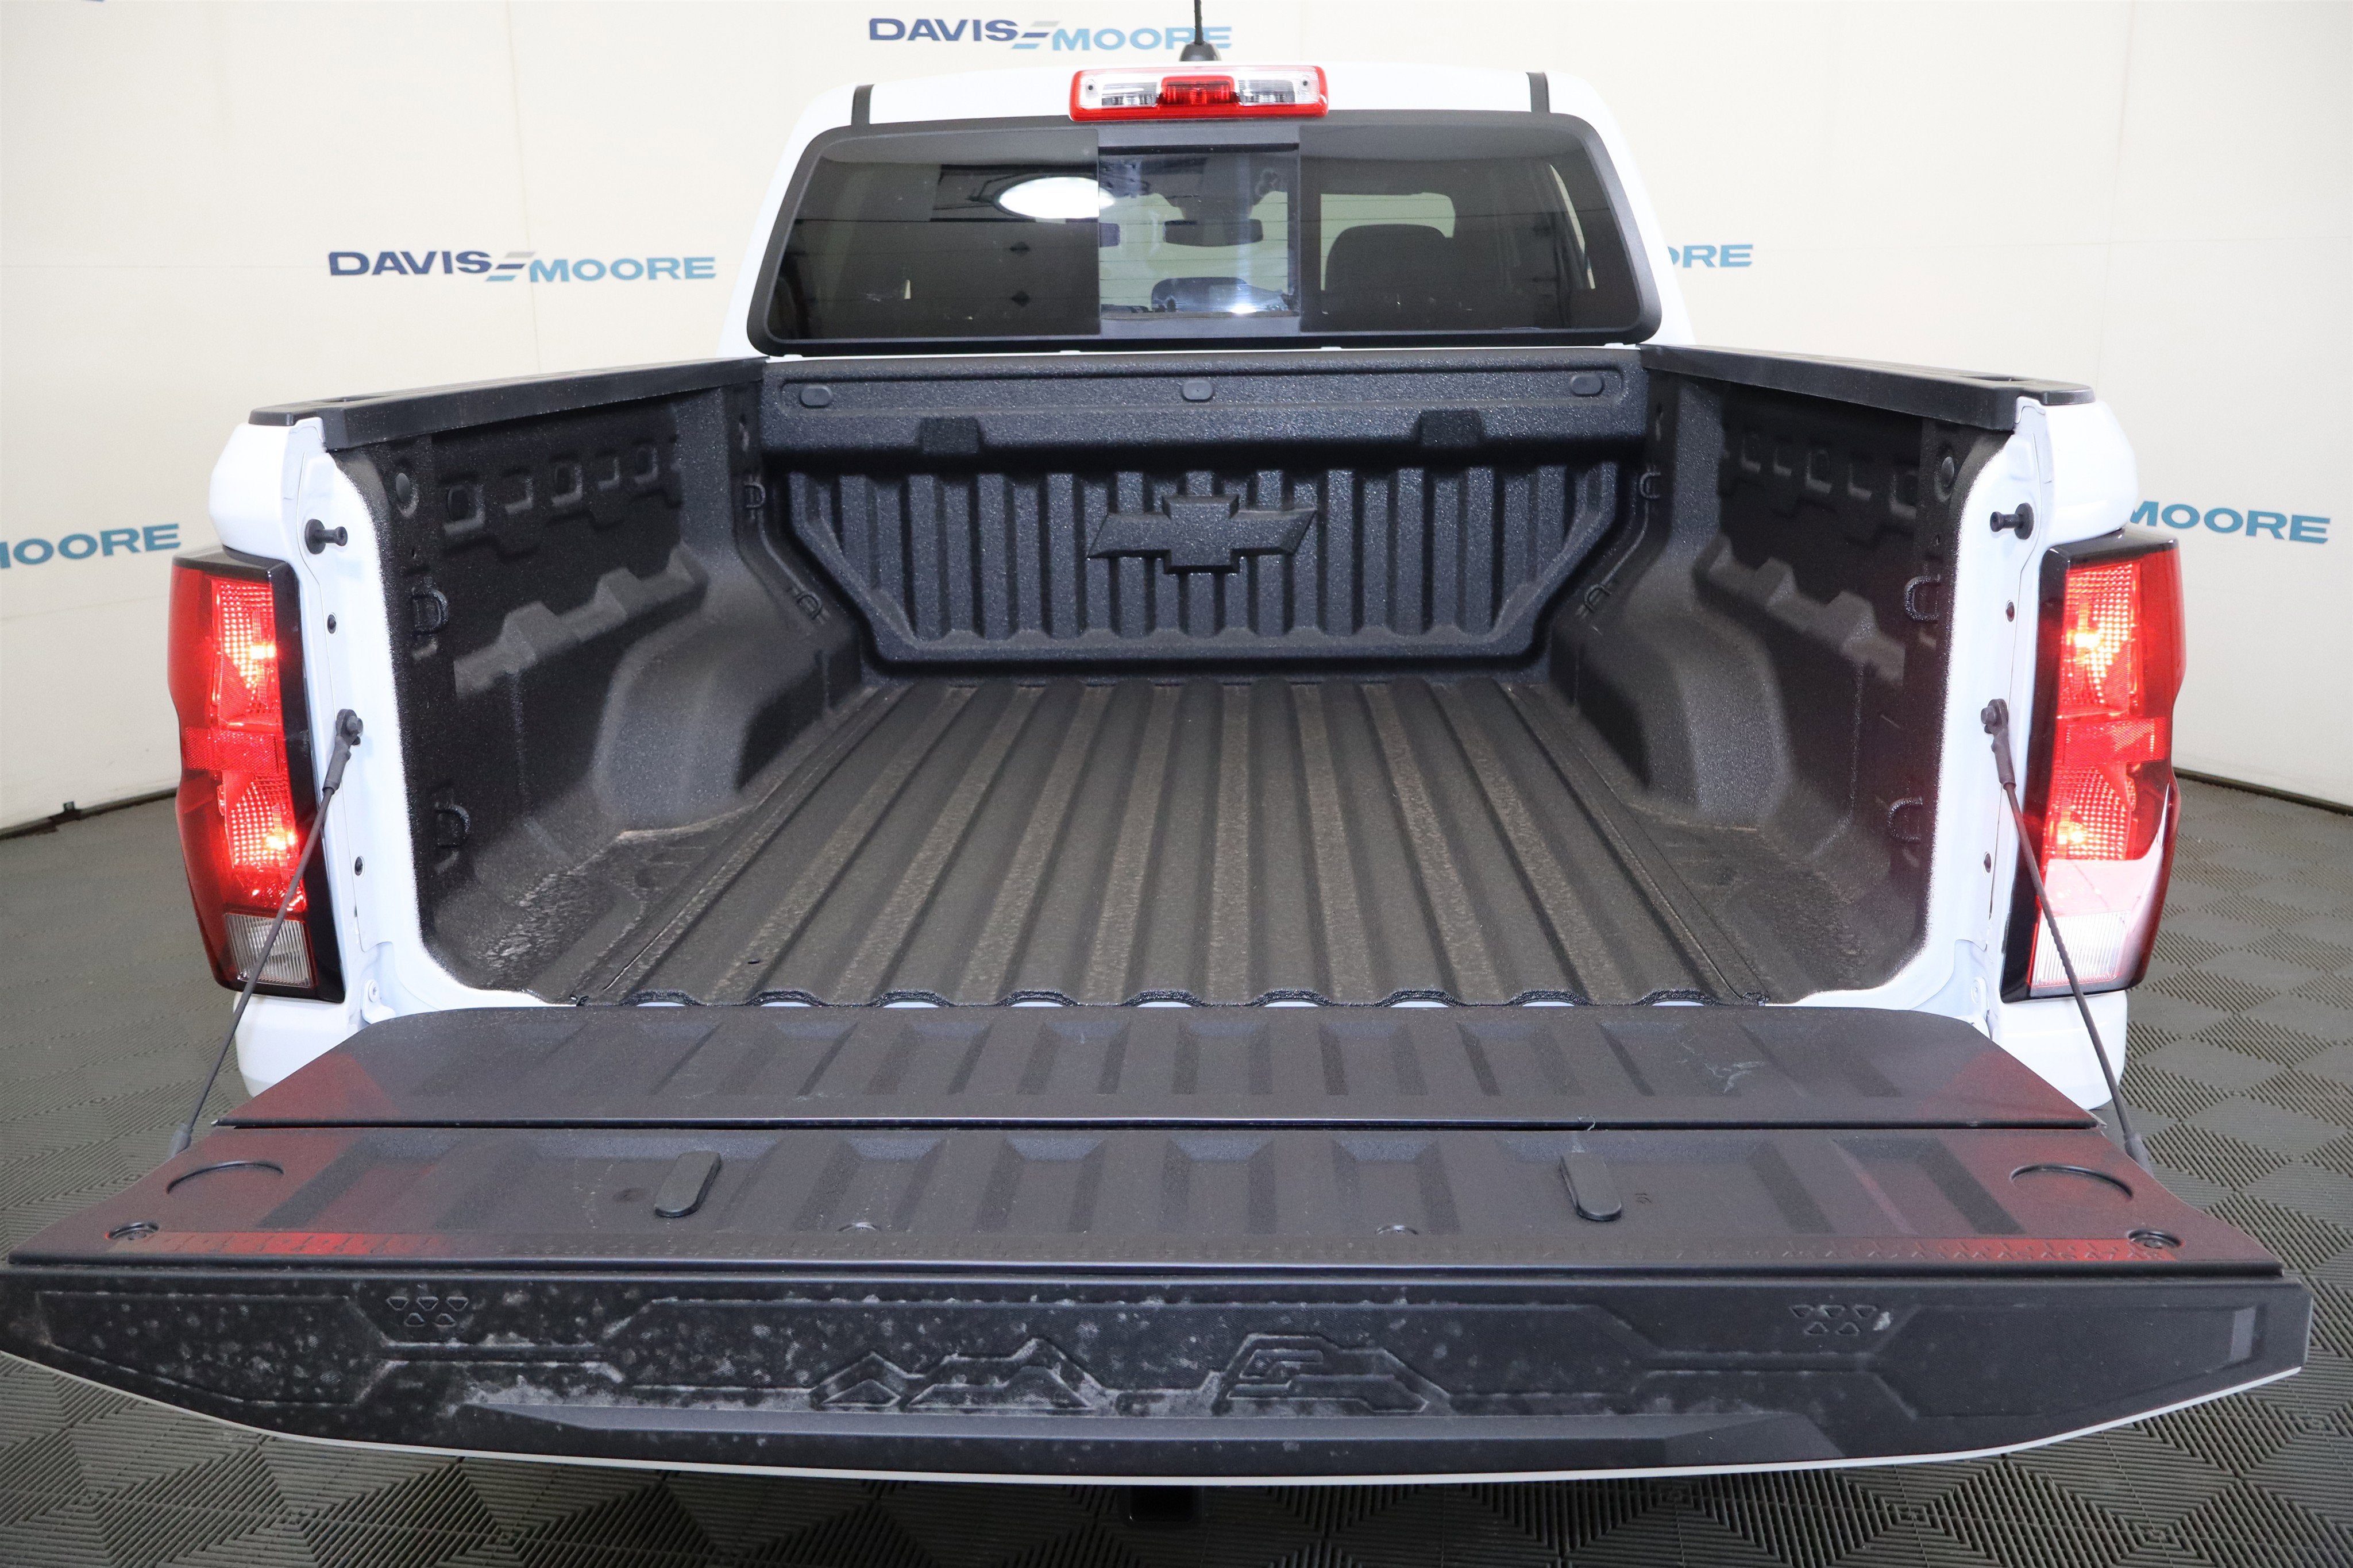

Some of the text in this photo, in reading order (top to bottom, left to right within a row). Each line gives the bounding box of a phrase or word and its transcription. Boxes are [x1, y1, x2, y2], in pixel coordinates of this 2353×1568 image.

[869, 18, 1018, 41] DAVIS
[329, 250, 716, 282] DAVIS MOORE
[0, 523, 181, 568] OORE
